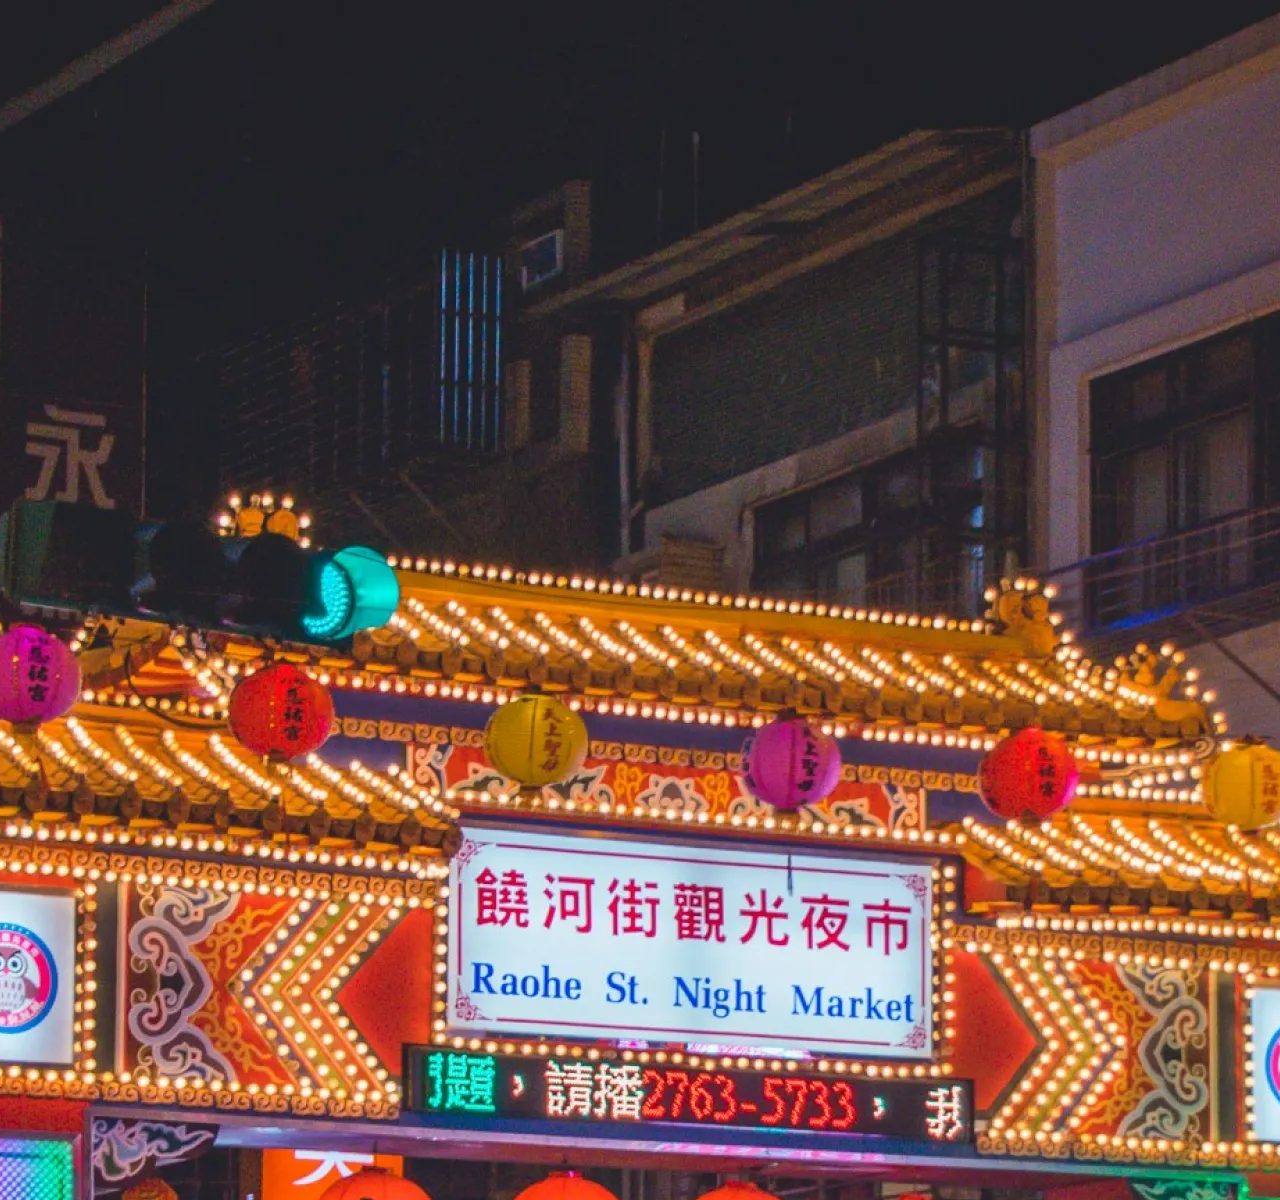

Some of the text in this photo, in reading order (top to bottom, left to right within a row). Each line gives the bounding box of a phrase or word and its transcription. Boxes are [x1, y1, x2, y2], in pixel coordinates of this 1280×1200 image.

[25, 404, 117, 509] 永
[474, 866, 914, 957] 饒河街觀光夜市
[470, 961, 916, 1024] Raohe St. Night Market
